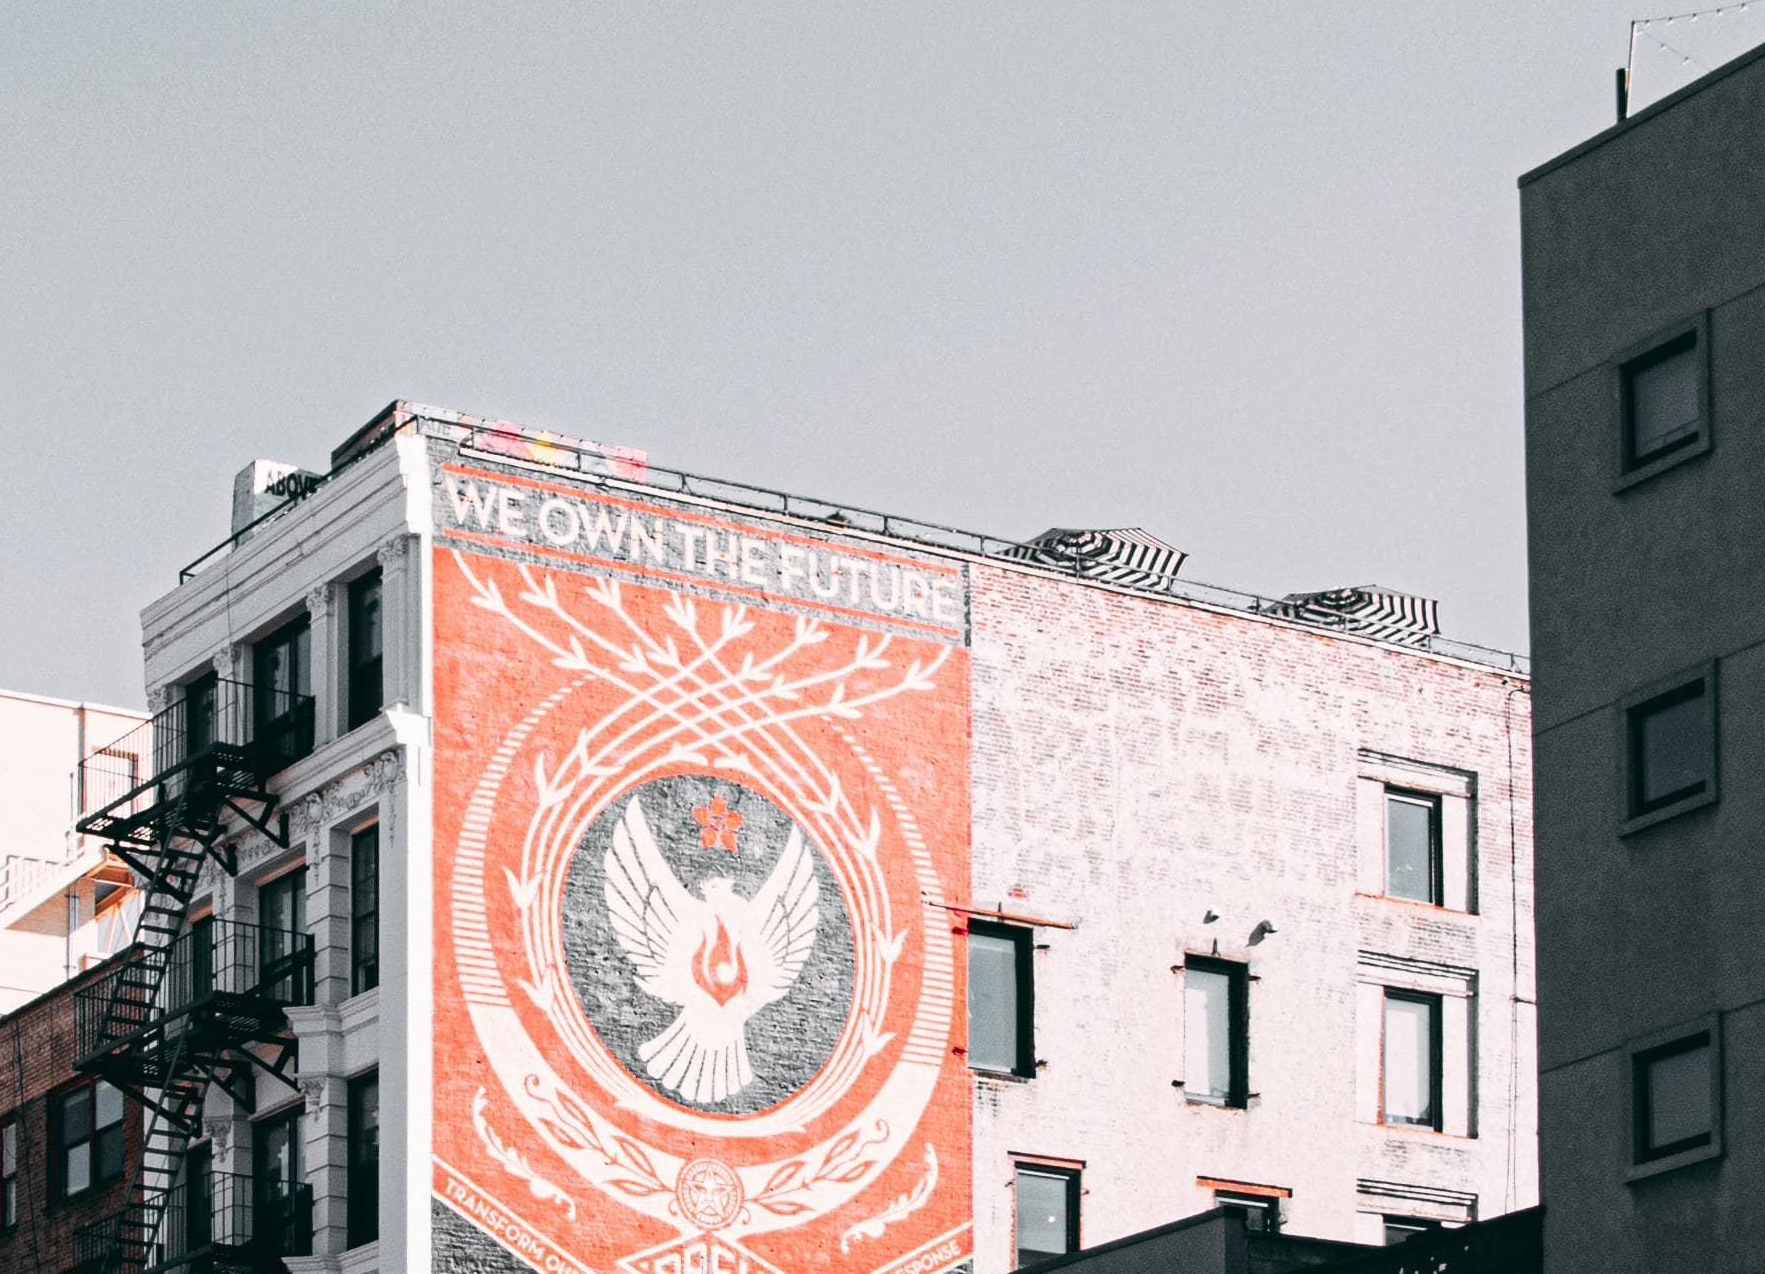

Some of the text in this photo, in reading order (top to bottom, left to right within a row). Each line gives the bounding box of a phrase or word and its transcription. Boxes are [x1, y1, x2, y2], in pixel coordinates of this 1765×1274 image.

[443, 477, 960, 626] WE OWN THE FUTURE
[444, 1177, 545, 1260] TRANSFORM
